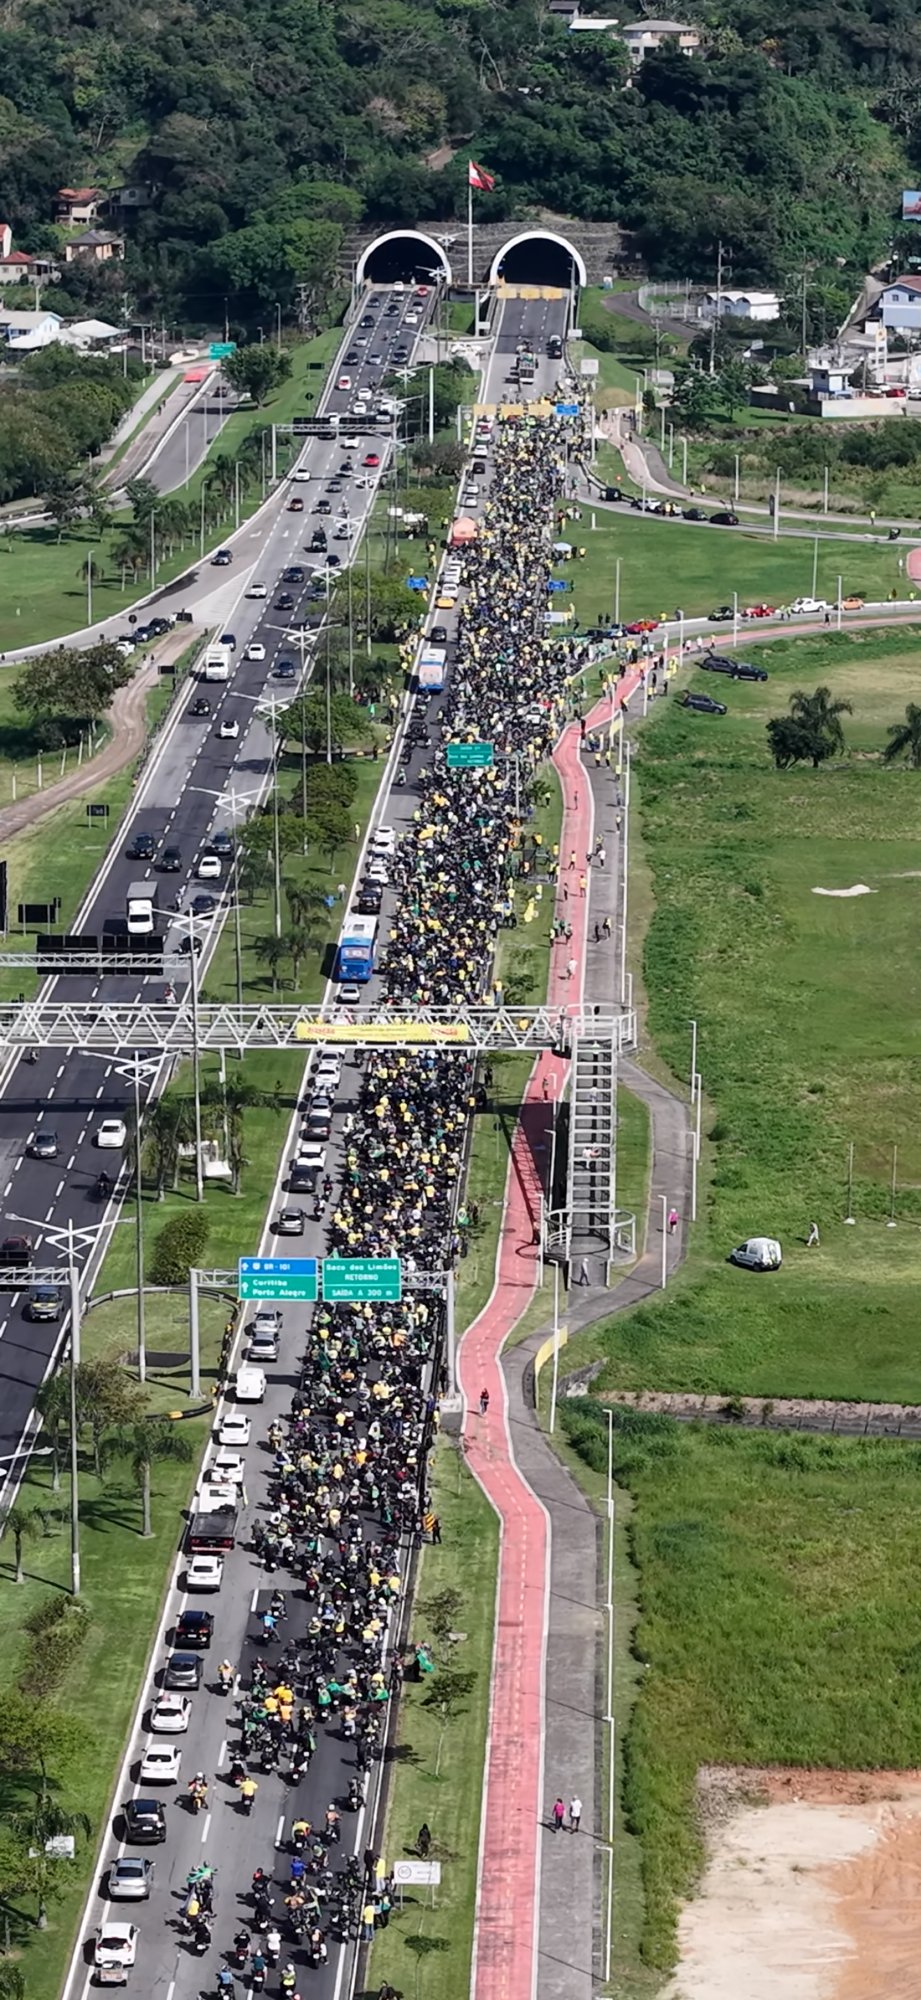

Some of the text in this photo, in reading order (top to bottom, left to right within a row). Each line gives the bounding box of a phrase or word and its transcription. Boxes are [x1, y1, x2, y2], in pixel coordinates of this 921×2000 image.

[349, 1263, 365, 1271] dos
[368, 1263, 397, 1271] Limões
[344, 1273, 379, 1281] RETORNO
[252, 1279, 288, 1287] Curitiba
[252, 1288, 306, 1297] Porto Alegre
